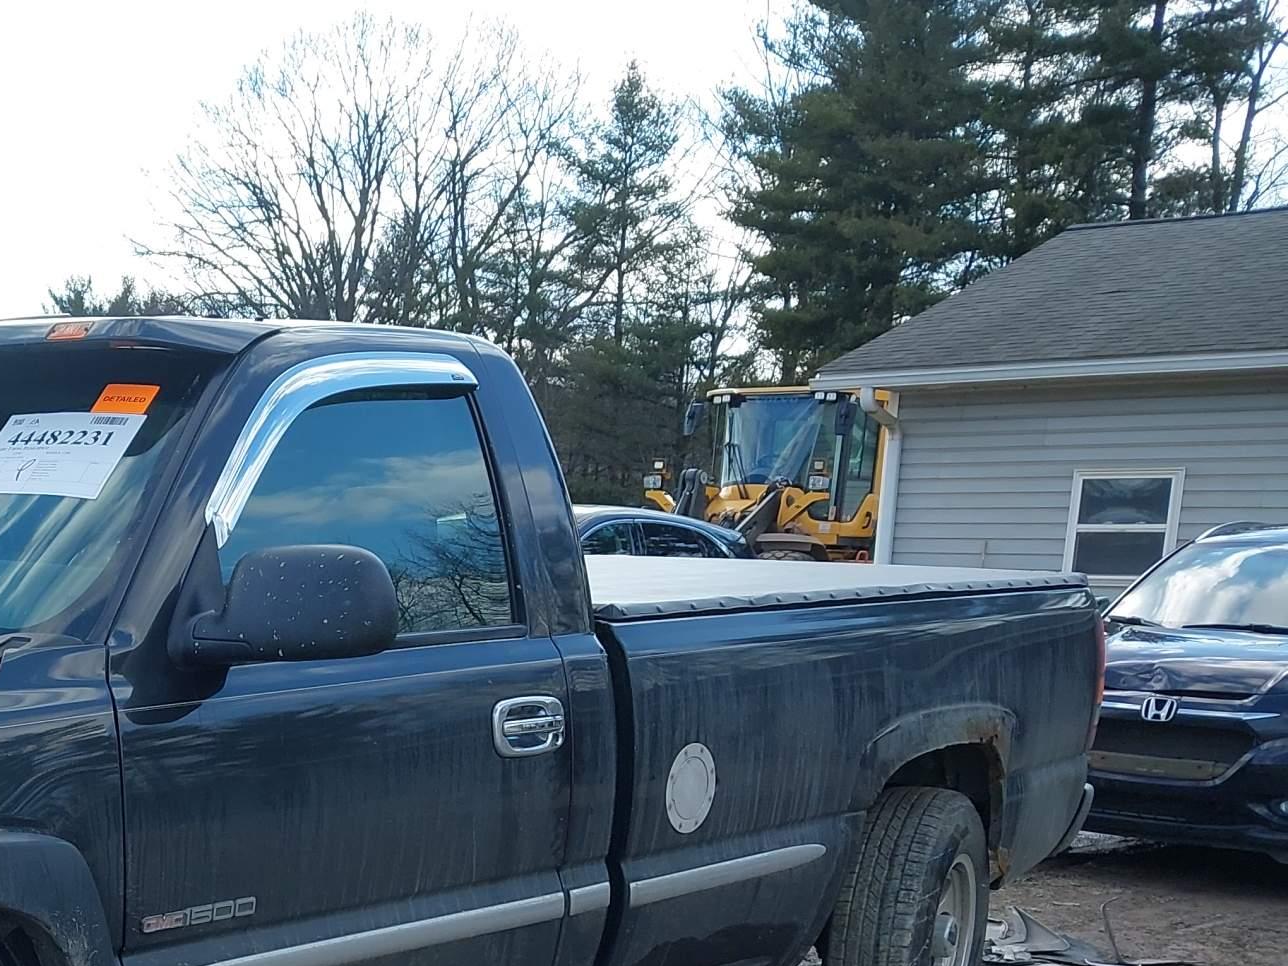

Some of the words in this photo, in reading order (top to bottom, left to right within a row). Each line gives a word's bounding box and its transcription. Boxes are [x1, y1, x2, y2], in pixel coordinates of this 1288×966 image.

[102, 394, 147, 404] DETAILED
[7, 430, 115, 447] 44482231
[183, 896, 257, 927] 1500
